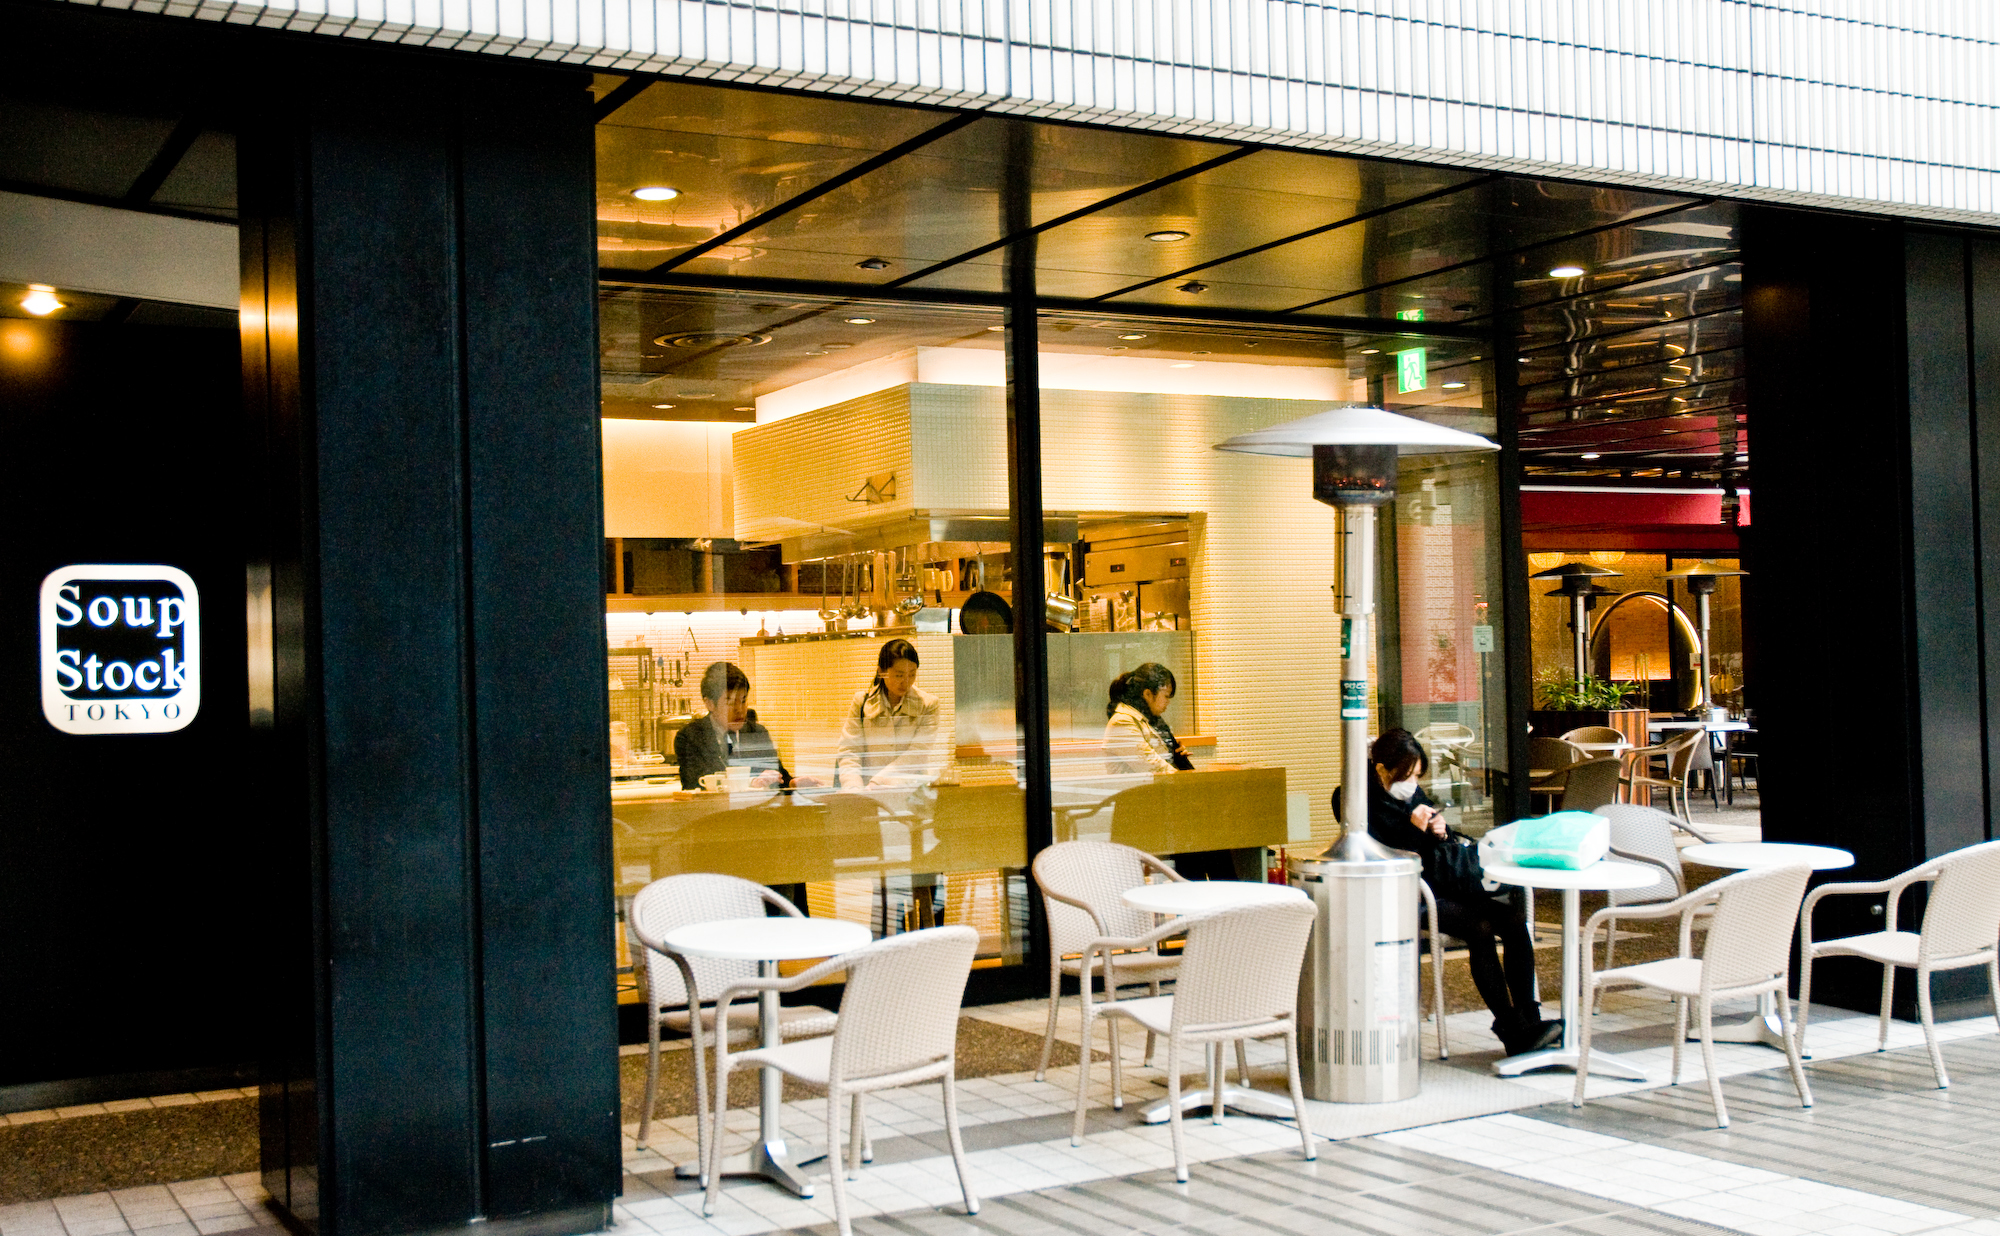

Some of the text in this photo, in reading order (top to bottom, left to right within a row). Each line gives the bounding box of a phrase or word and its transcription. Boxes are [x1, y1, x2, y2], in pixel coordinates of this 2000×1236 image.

[56, 585, 186, 638] Soup
[56, 648, 187, 691] Stock
[64, 703, 181, 721] TOKYO
